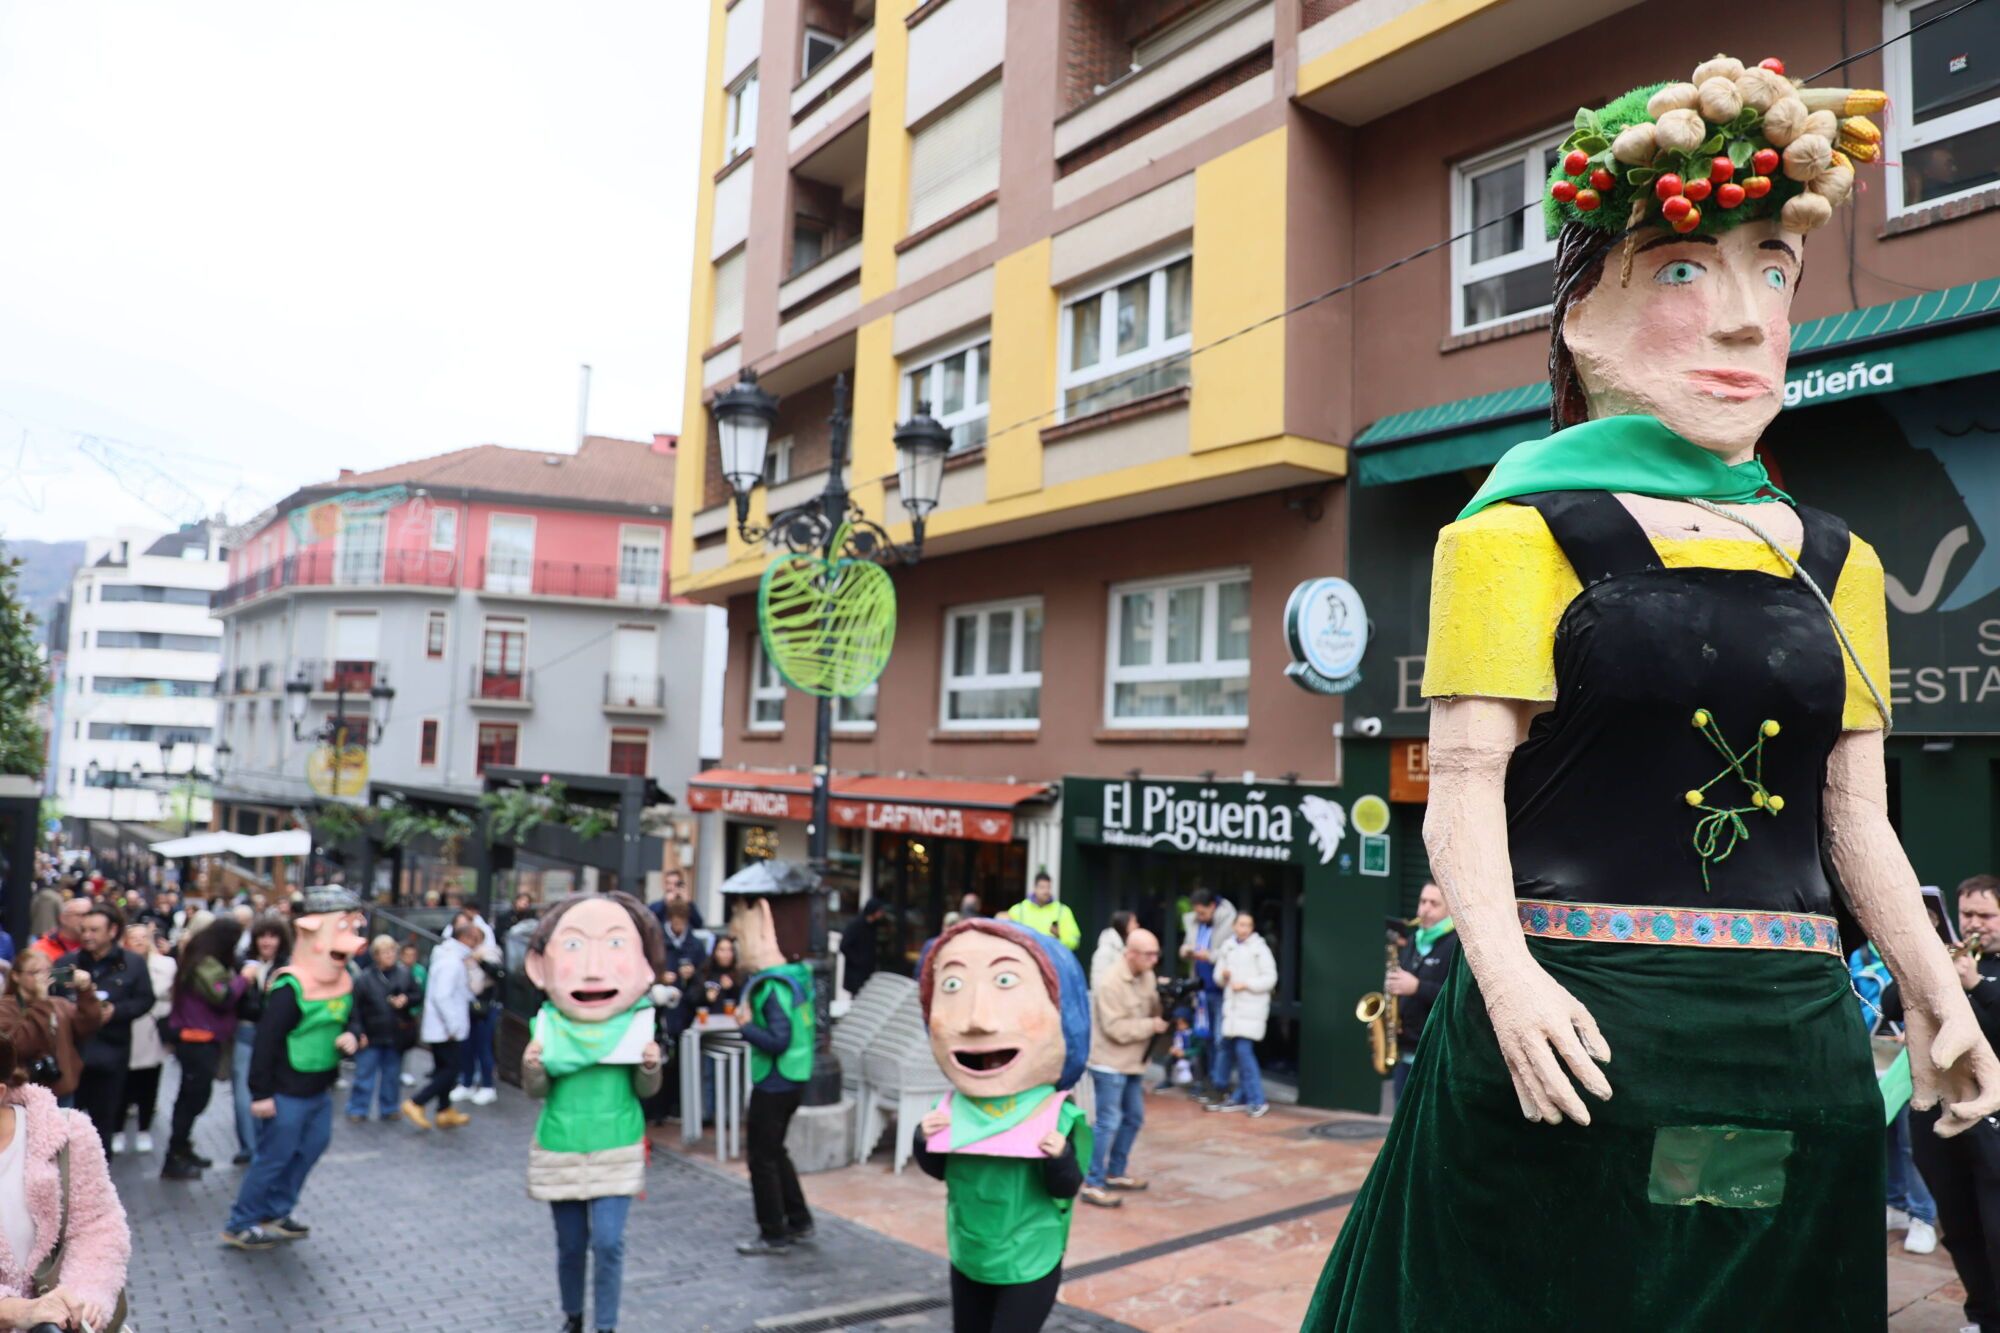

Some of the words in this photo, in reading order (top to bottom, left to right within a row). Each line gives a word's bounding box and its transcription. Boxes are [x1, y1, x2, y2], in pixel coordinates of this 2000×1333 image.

[1103, 781, 1132, 829] El
[1142, 785, 1293, 850] Pigüeña
[1197, 838, 1291, 861] Restaurante
